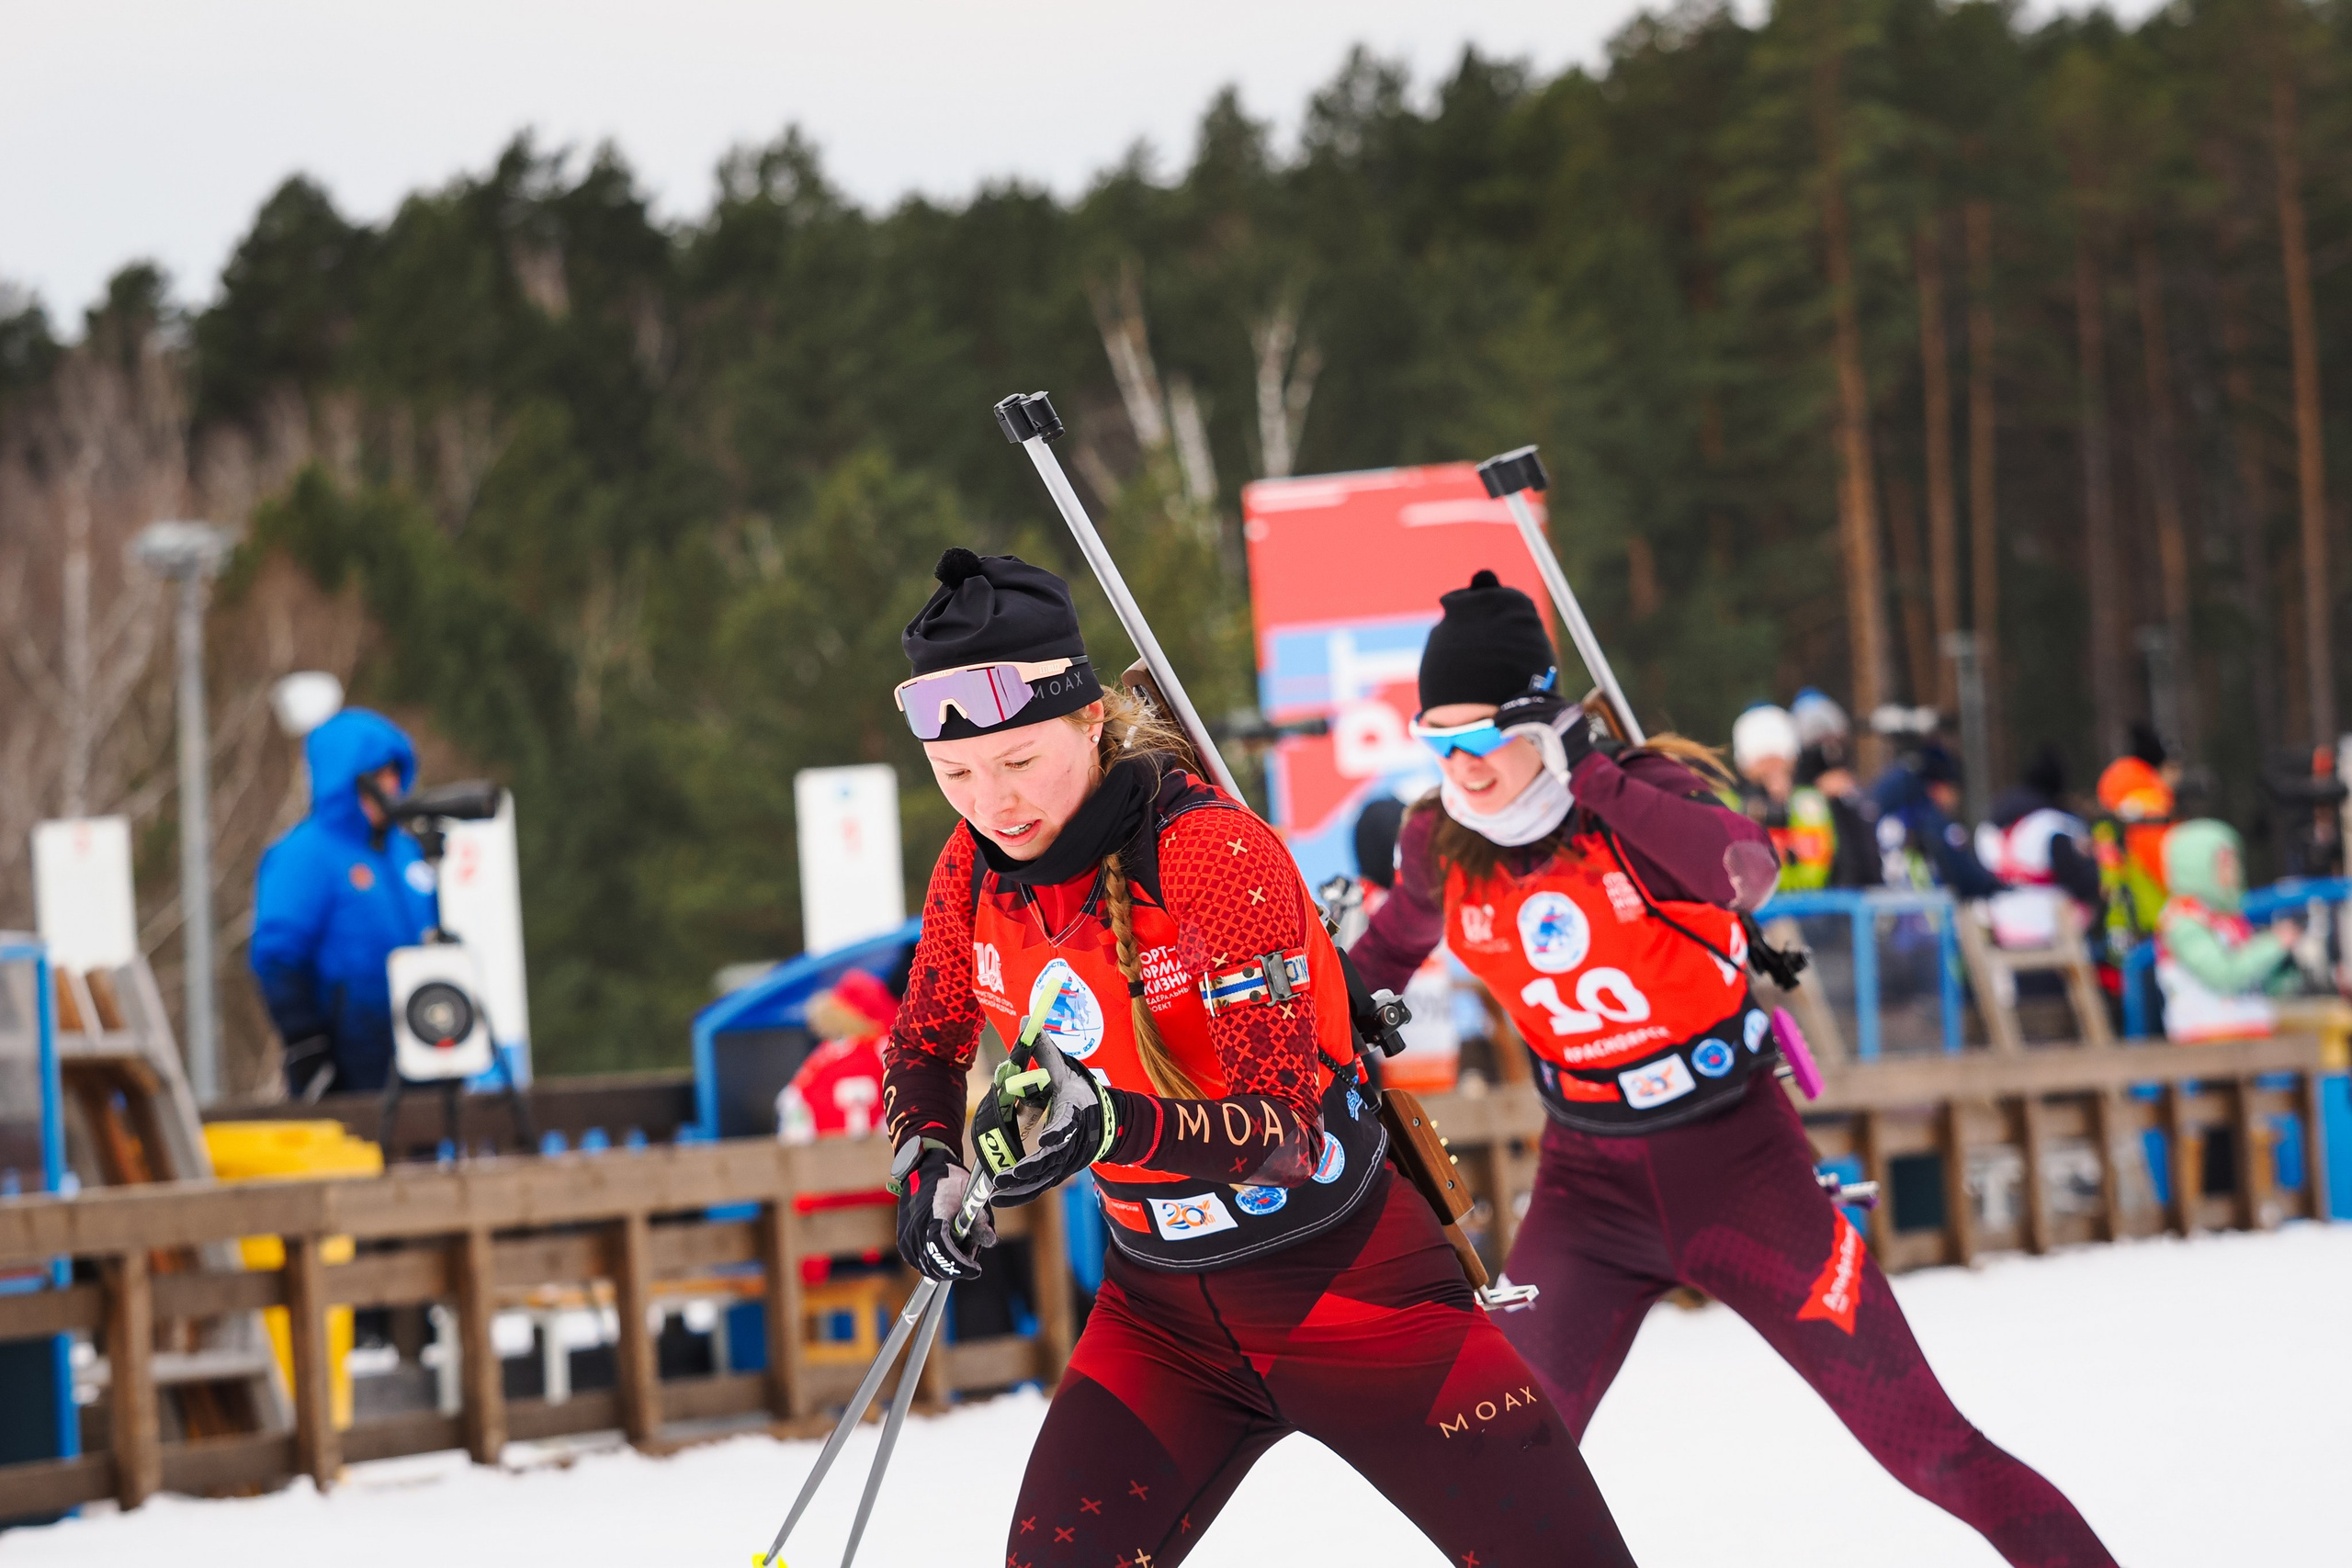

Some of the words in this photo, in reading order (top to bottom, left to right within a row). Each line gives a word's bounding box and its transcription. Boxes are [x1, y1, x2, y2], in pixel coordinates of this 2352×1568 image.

[1150, 1001, 1171, 1013] ОЕКТ
[1521, 966, 1651, 1036] 10
[1439, 1385, 1537, 1438] MOAX
